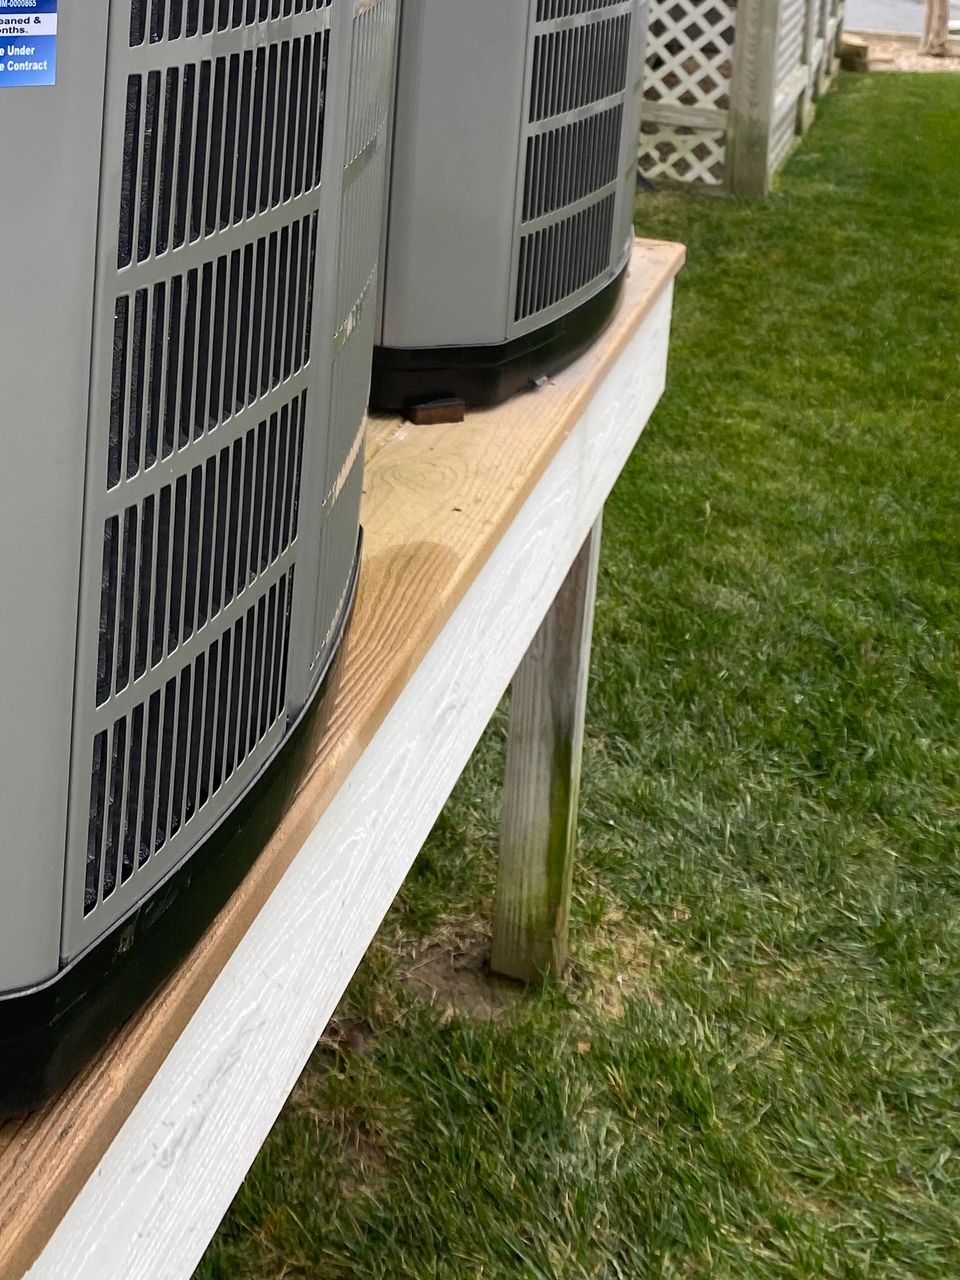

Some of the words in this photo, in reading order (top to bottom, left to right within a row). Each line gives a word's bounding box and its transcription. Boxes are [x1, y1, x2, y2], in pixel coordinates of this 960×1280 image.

[33, 16, 41, 24] &
[8, 45, 35, 56] Under
[7, 60, 48, 71] Contract
